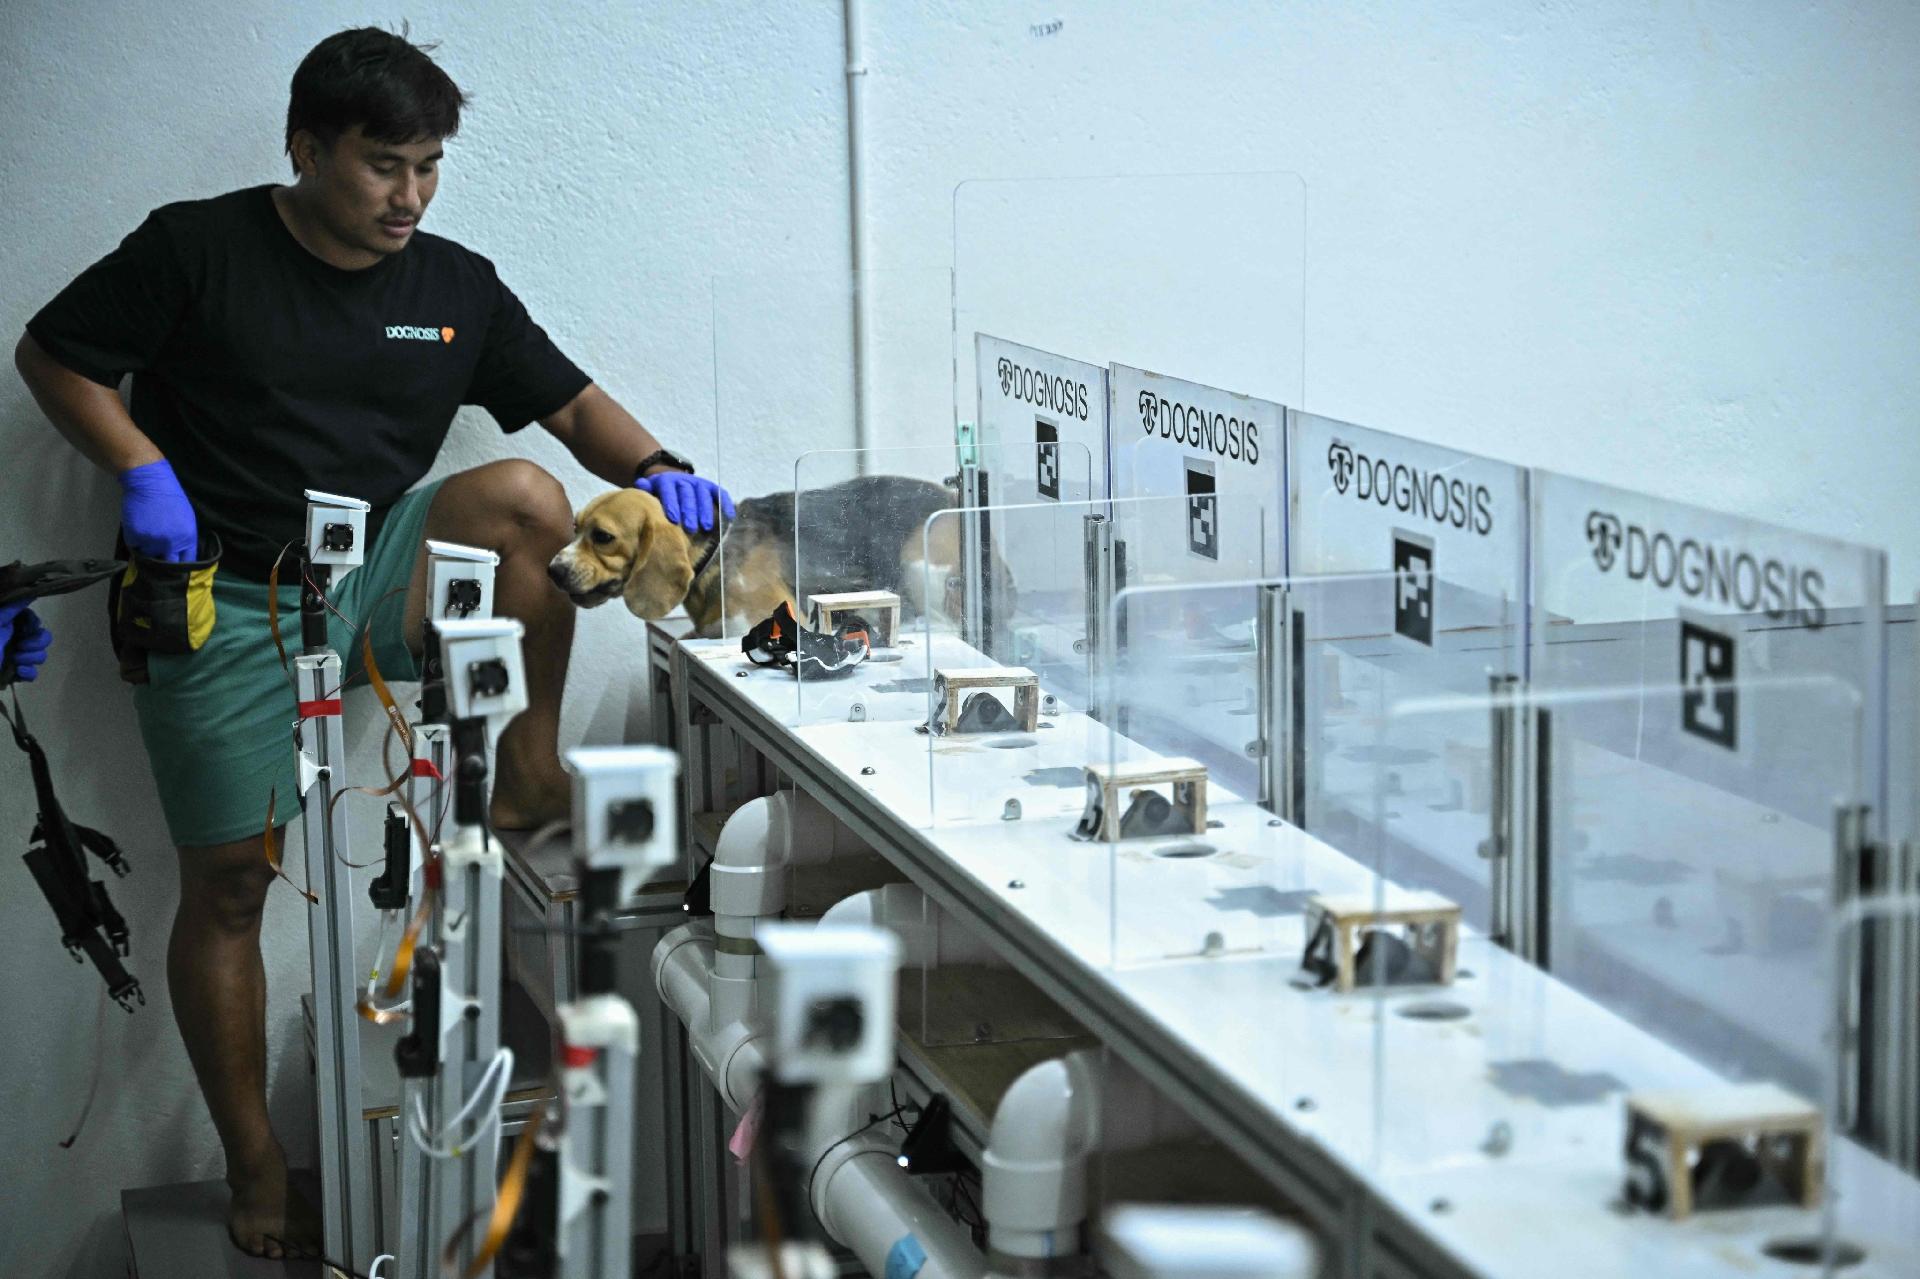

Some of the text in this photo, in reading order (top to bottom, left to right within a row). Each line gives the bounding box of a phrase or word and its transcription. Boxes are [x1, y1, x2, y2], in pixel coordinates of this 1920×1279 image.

[385, 325, 440, 341] DOGNOSIS
[1013, 364, 1089, 422] DOGNOSIS
[1159, 398, 1260, 466] DOGNOSIS
[1356, 452, 1494, 537] DOGNOSIS
[1626, 525, 1826, 630] DOGNOSIS
[1302, 909, 1338, 987] 4
